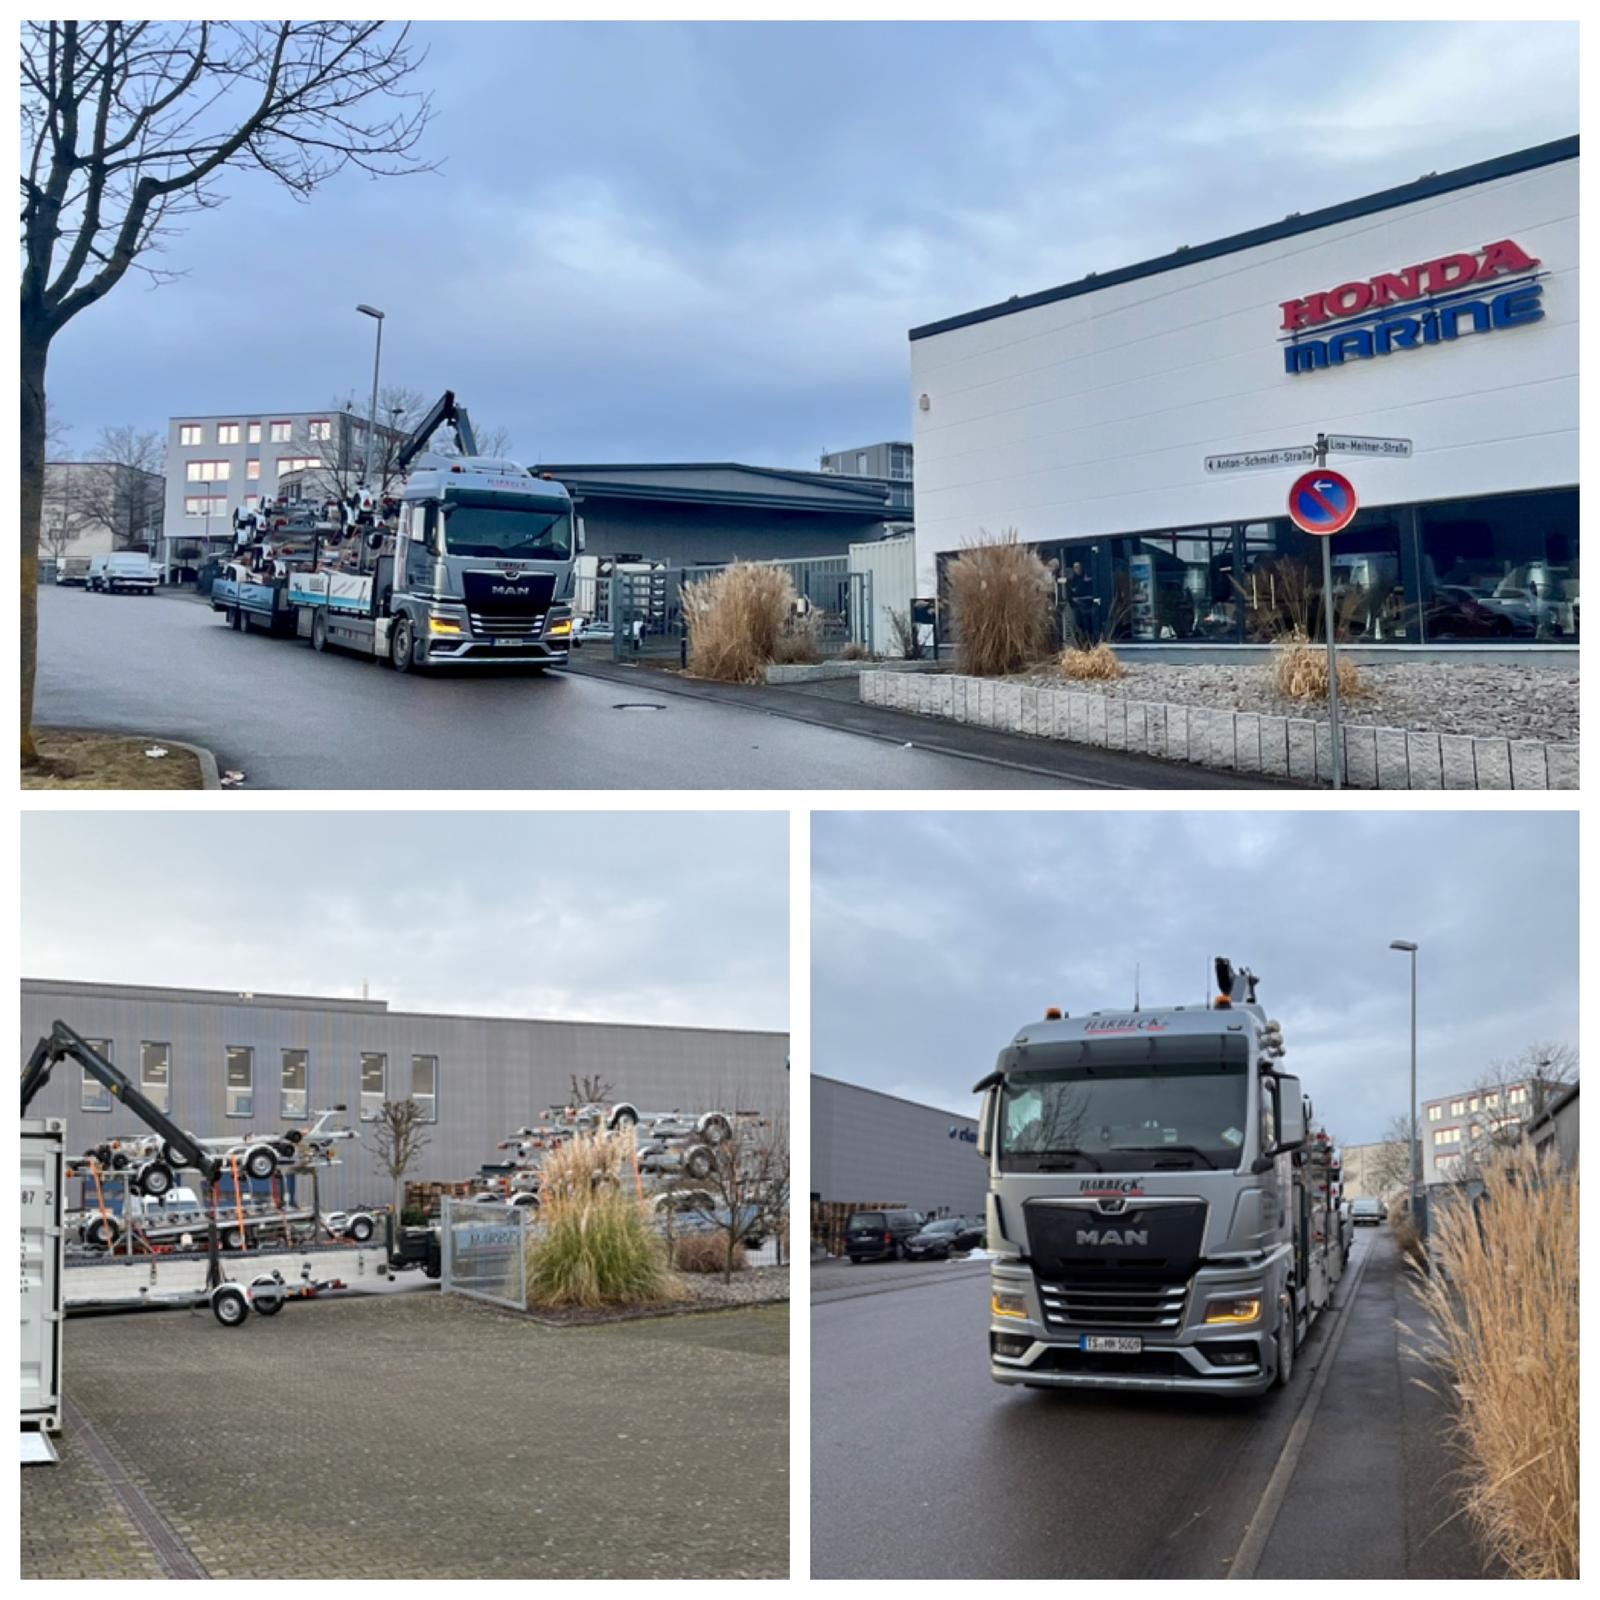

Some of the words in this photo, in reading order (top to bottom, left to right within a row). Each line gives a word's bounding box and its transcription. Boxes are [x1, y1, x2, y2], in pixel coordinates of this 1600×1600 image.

[1279, 239, 1541, 330] HONDA
[1330, 440, 1408, 454] Lise-Meitner-Straße
[1217, 450, 1312, 469] Anton-Schmidt-Straße
[492, 586, 529, 595] MAN
[1080, 1178, 1143, 1193] HARBECK
[1076, 1230, 1148, 1245] MAN
